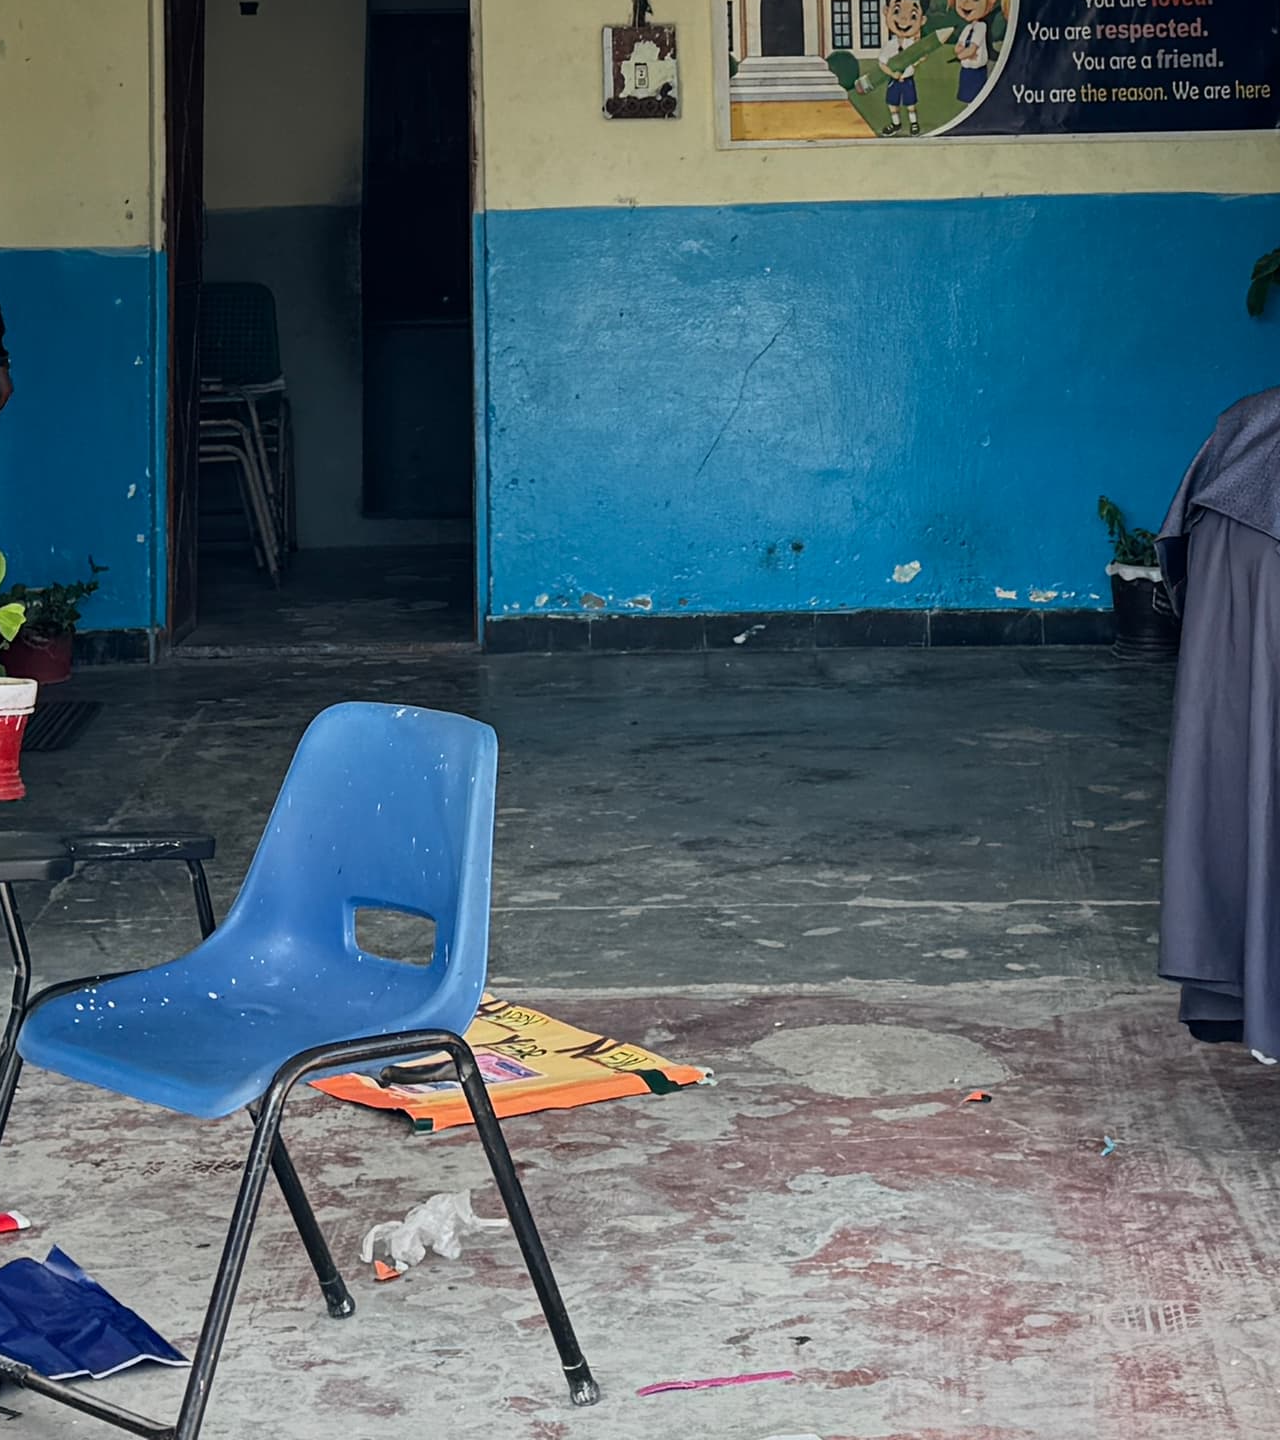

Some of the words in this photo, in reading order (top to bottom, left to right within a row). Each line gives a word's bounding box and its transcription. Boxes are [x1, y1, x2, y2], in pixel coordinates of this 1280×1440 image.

[1027, 21, 1060, 41] You
[1064, 25, 1092, 40] are
[1095, 17, 1208, 43] respected.
[1072, 51, 1105, 71] You
[1109, 55, 1137, 70] are
[1140, 55, 1152, 69] a
[1156, 48, 1224, 69] friend.
[1011, 84, 1044, 103] You
[1049, 88, 1076, 103] are
[1080, 83, 1107, 102] the
[1111, 85, 1168, 102] reason.
[1172, 81, 1199, 100] We
[1204, 85, 1231, 100] are
[1235, 80, 1271, 99] here
